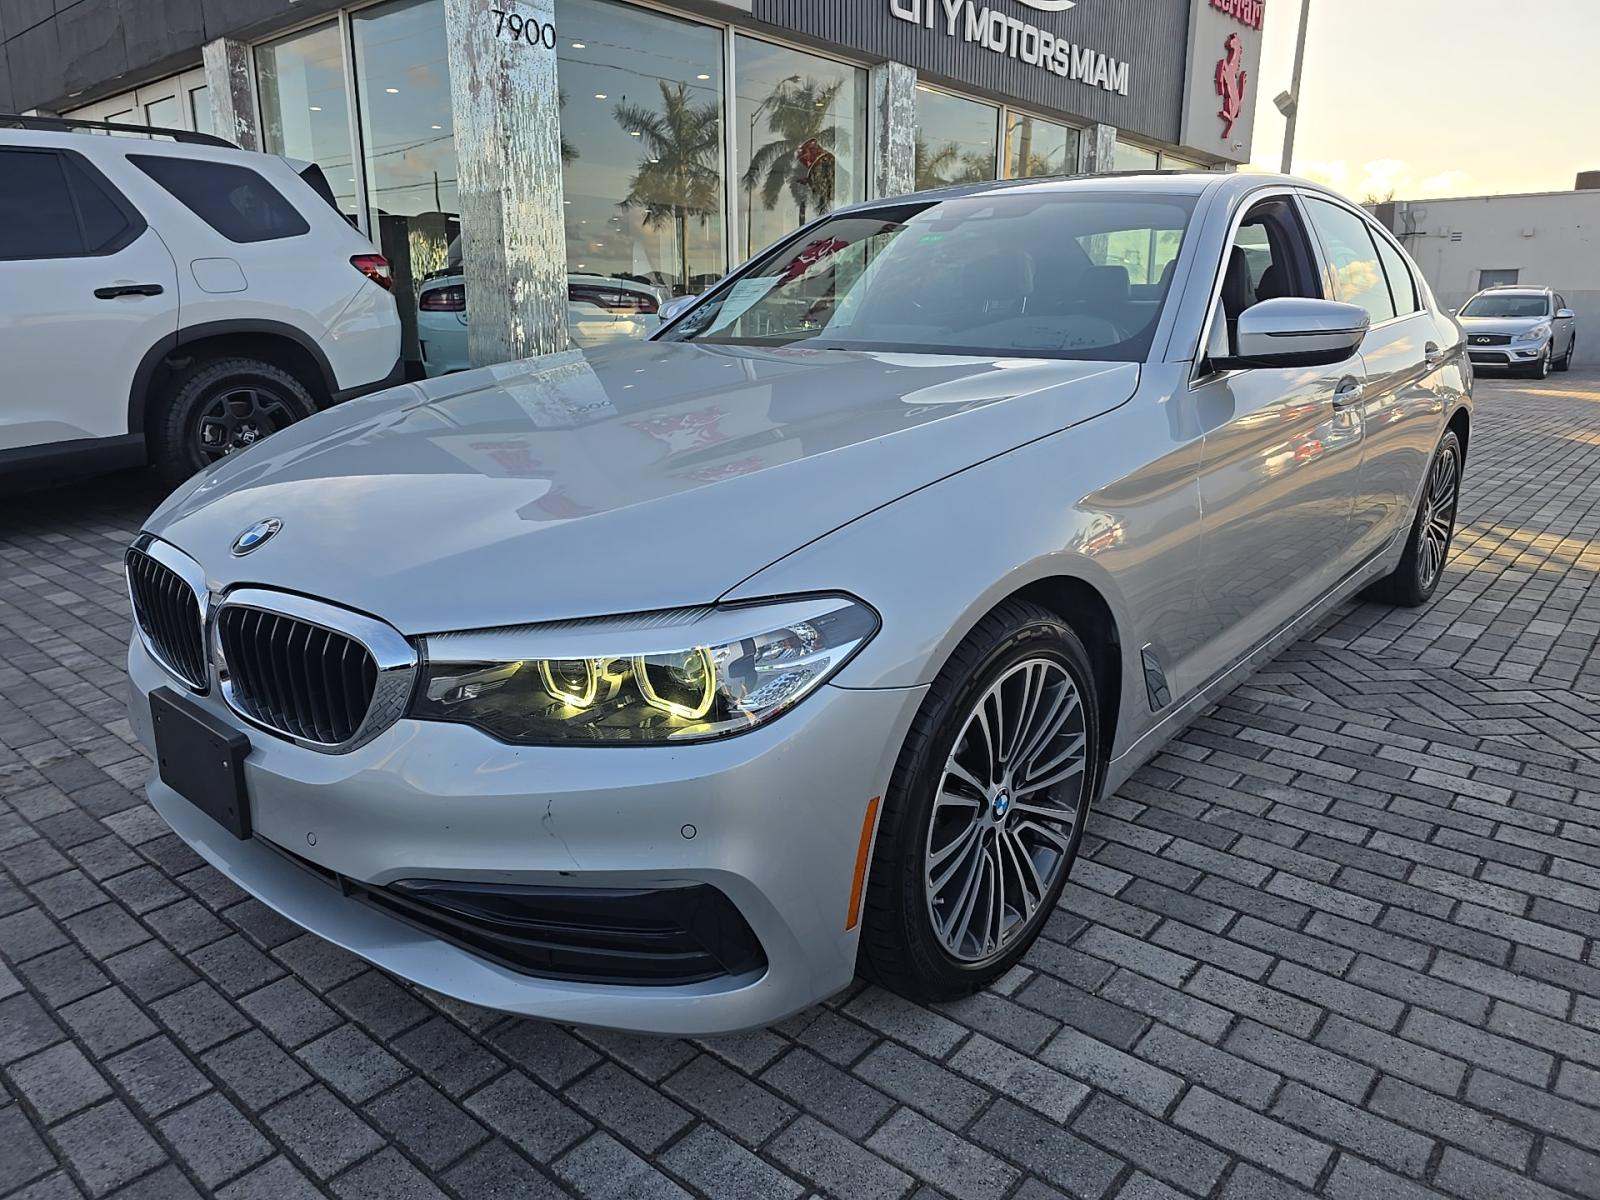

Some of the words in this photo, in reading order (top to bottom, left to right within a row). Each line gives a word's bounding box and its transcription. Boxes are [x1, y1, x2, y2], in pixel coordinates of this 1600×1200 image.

[491, 9, 556, 50] 7900
[964, 1, 1070, 77] MOTORS
[1069, 44, 1129, 96] MIAMI
